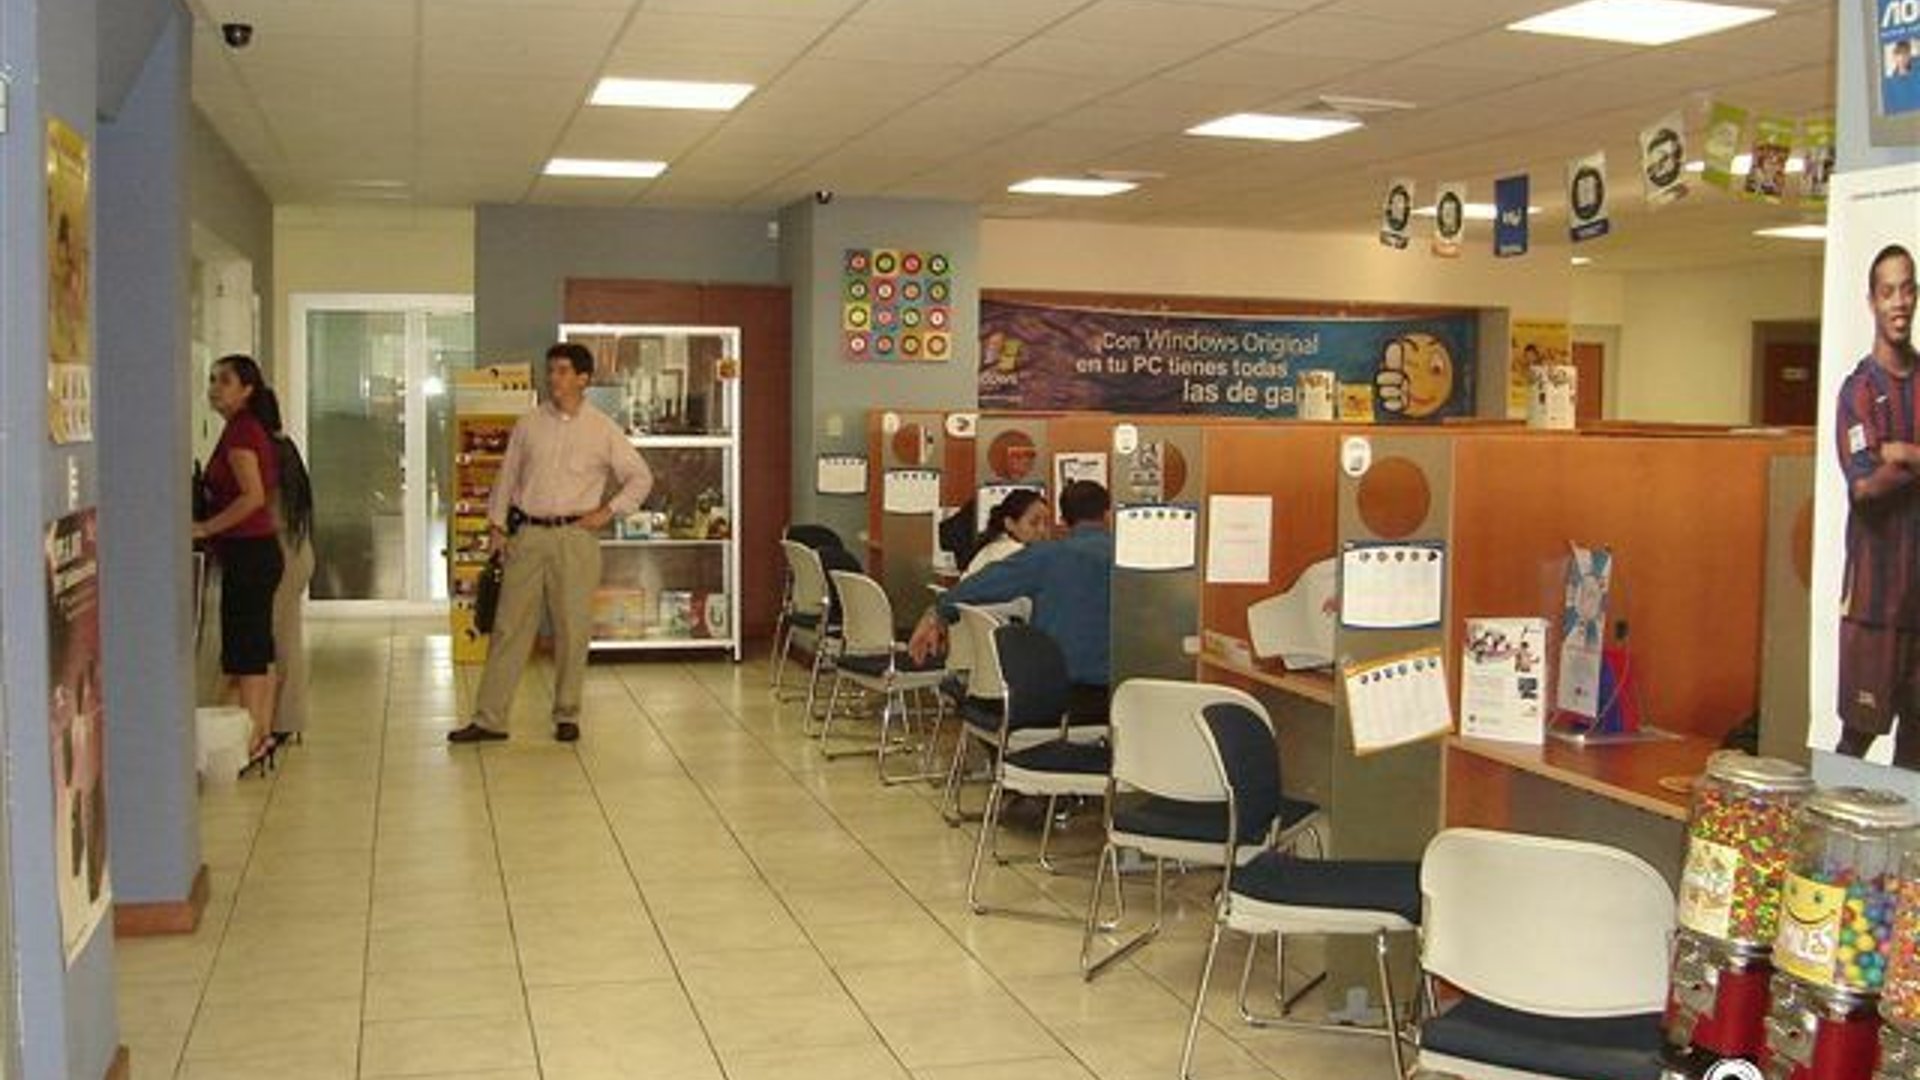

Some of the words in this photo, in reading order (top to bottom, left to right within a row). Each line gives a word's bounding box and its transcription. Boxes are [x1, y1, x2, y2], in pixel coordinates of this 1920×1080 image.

[1102, 331, 1141, 350] Con
[1145, 328, 1239, 352] Windows
[1241, 332, 1319, 361] Original
[1076, 358, 1101, 374] en
[1107, 356, 1128, 374] tu
[1133, 356, 1162, 375] PC
[1168, 357, 1228, 377] tienes
[1233, 358, 1288, 378] todas
[1183, 379, 1219, 403] las
[1226, 380, 1258, 403] de
[1265, 386, 1297, 409] ga
